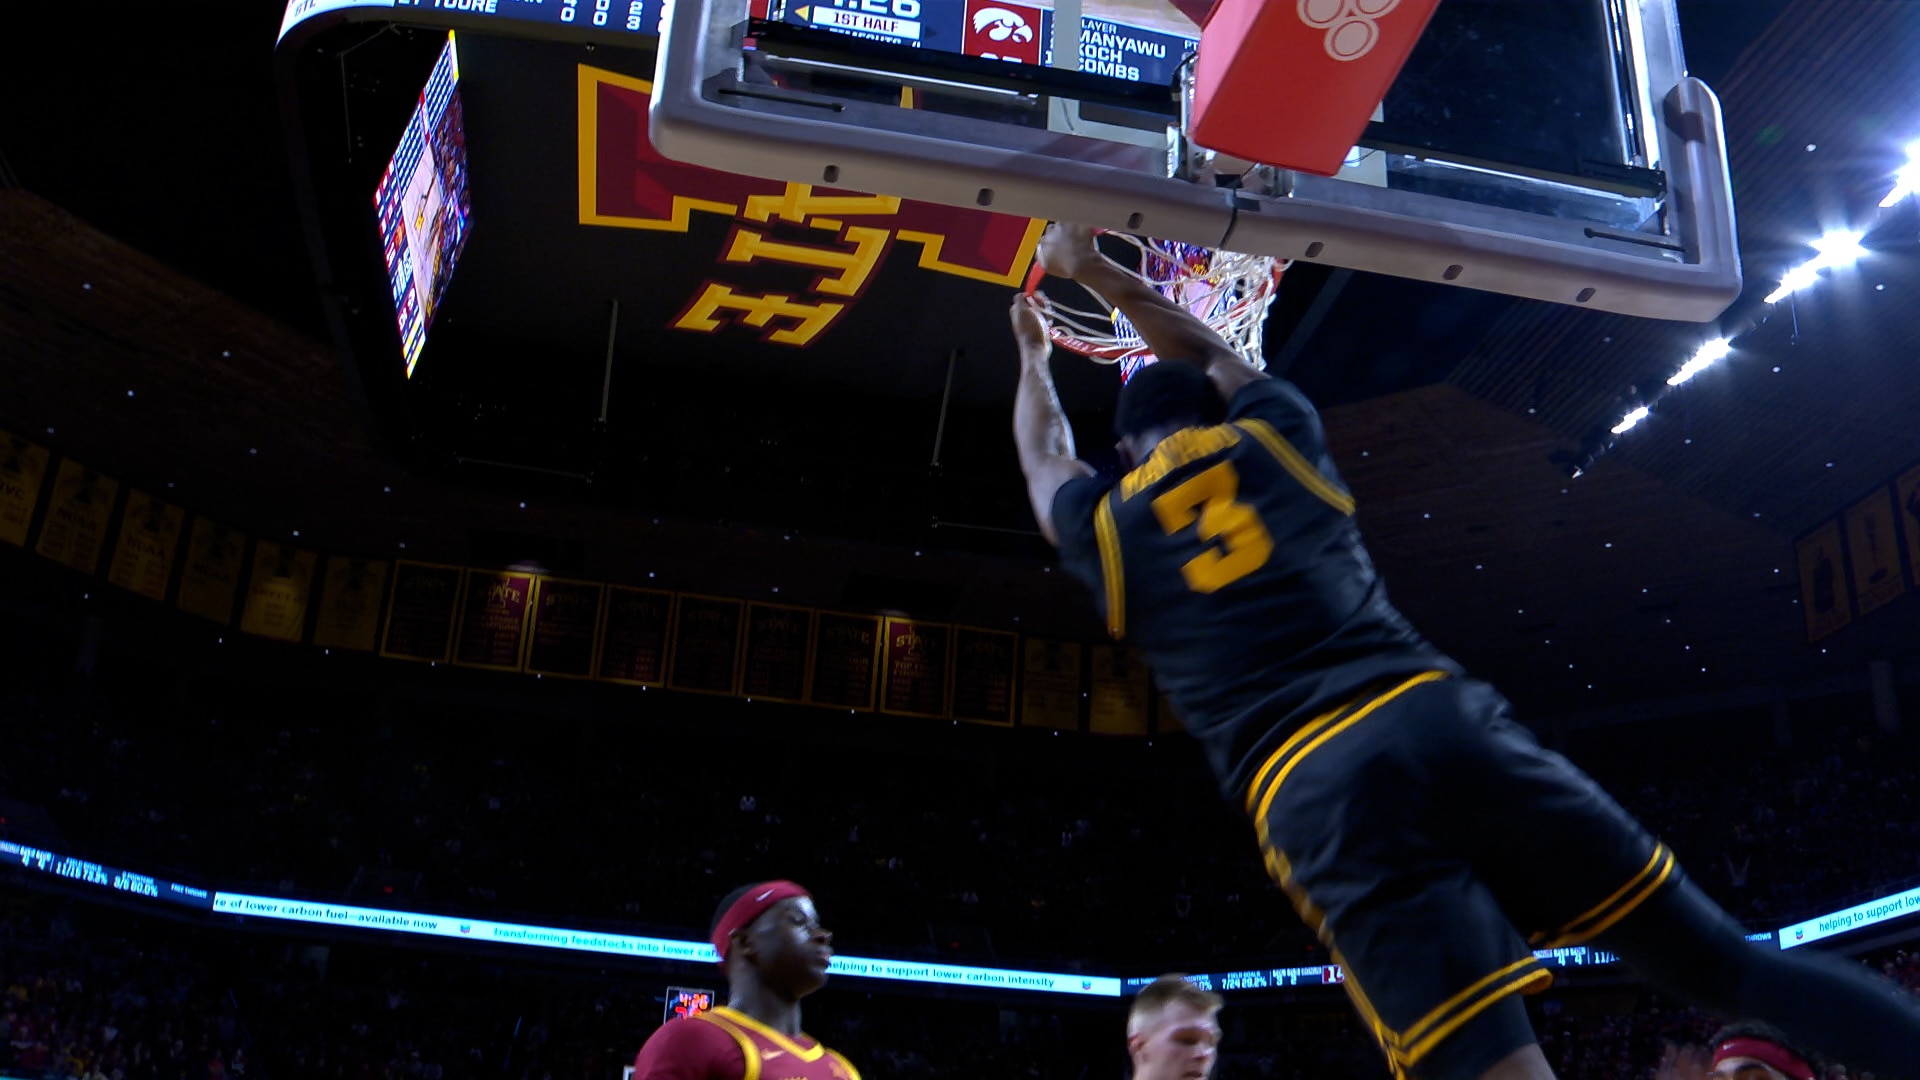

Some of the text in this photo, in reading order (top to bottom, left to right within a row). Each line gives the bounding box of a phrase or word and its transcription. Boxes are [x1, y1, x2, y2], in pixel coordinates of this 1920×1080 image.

[561, 7, 575, 22] 0
[593, 11, 608, 26] 0
[626, 15, 641, 30] 3
[834, 12, 899, 33] 1ST HALF
[1081, 19, 1199, 51] LAYER PT
[1151, 459, 1275, 595] 3
[230, 899, 242, 908] of
[246, 899, 278, 912] lower
[282, 906, 323, 918] carbon
[413, 919, 438, 930] now
[1819, 915, 1852, 933] helping
[1853, 911, 1864, 922] to
[1866, 898, 1903, 919] support
[494, 927, 568, 945] transforming
[571, 935, 634, 950] feedstocks
[637, 941, 660, 953] into
[663, 944, 694, 956] lower
[1594, 951, 1620, 964] 11/1
[871, 963, 883, 973] to
[886, 967, 929, 977] support
[933, 968, 962, 980] lower
[966, 972, 1005, 983] carbon
[1008, 975, 1055, 989] intensity
